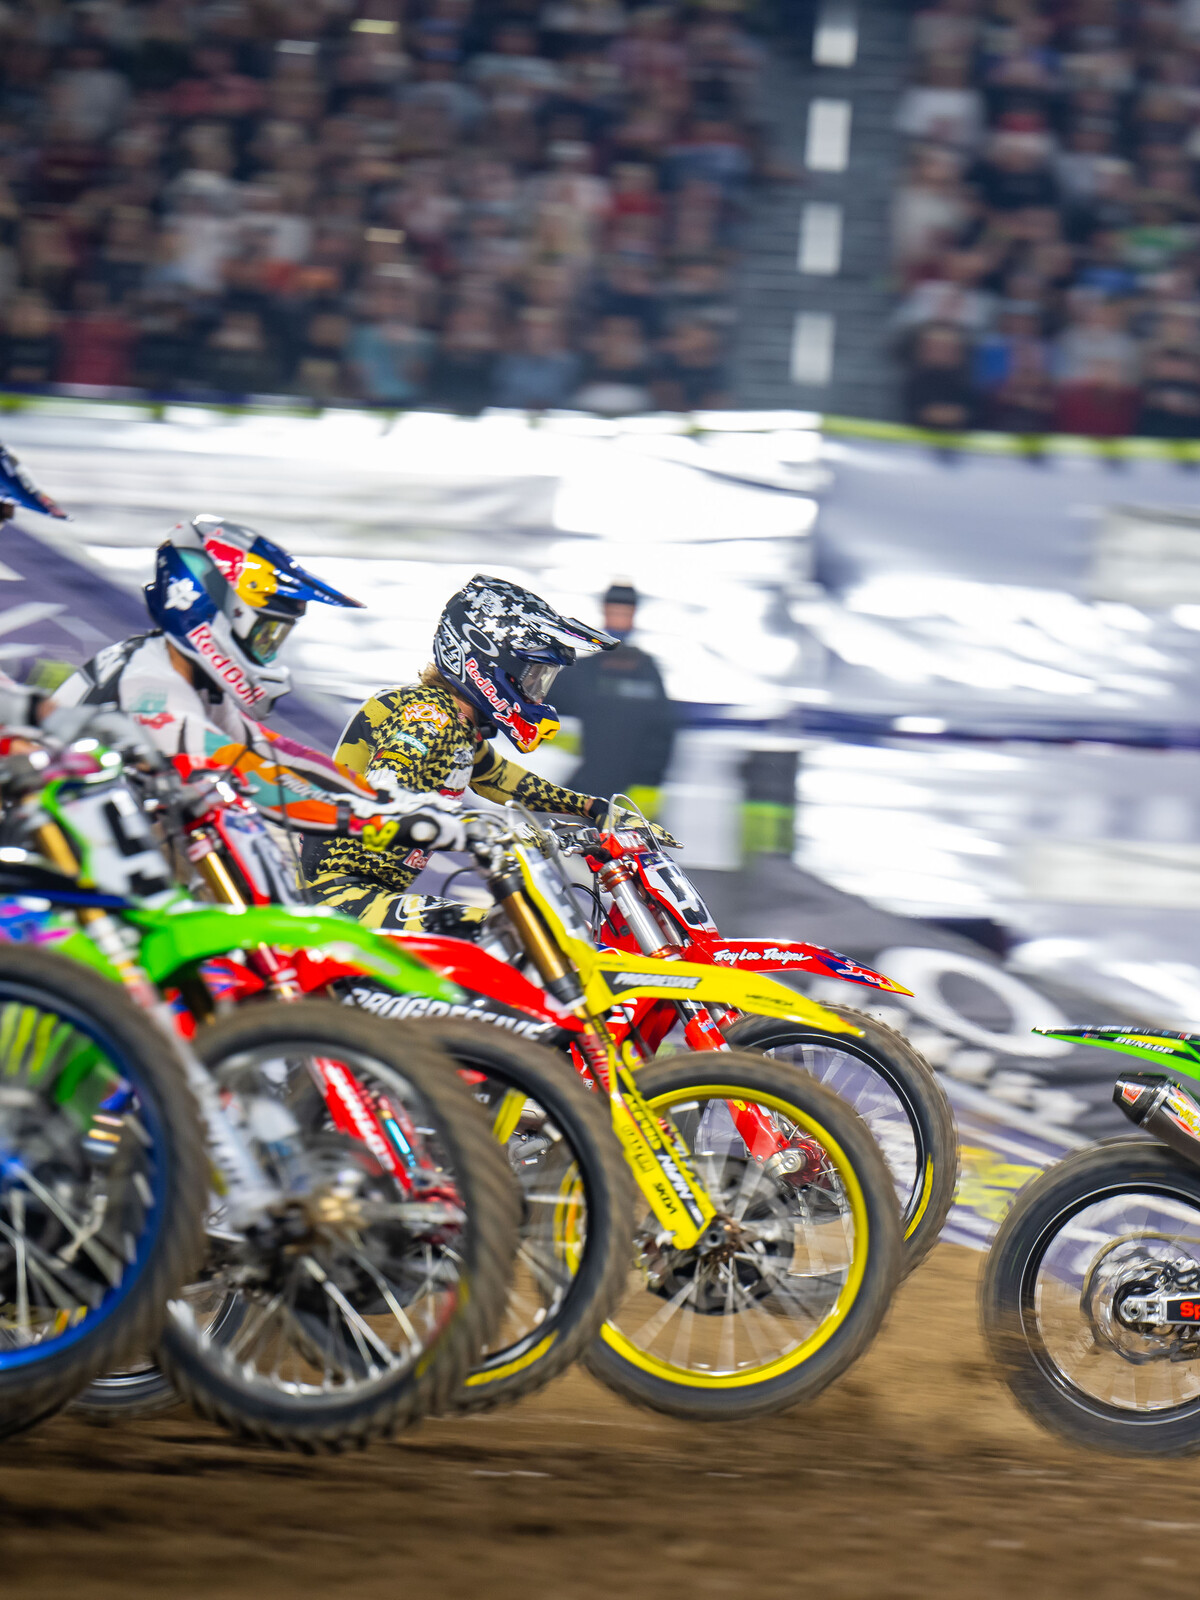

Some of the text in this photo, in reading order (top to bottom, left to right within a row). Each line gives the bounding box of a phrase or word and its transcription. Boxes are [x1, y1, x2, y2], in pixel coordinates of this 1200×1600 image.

[186, 622, 268, 707] Red Bull
[465, 657, 510, 713] Red Bull
[713, 947, 813, 966] Troy Lee Designs
[1113, 1036, 1174, 1054] DUNLOP
